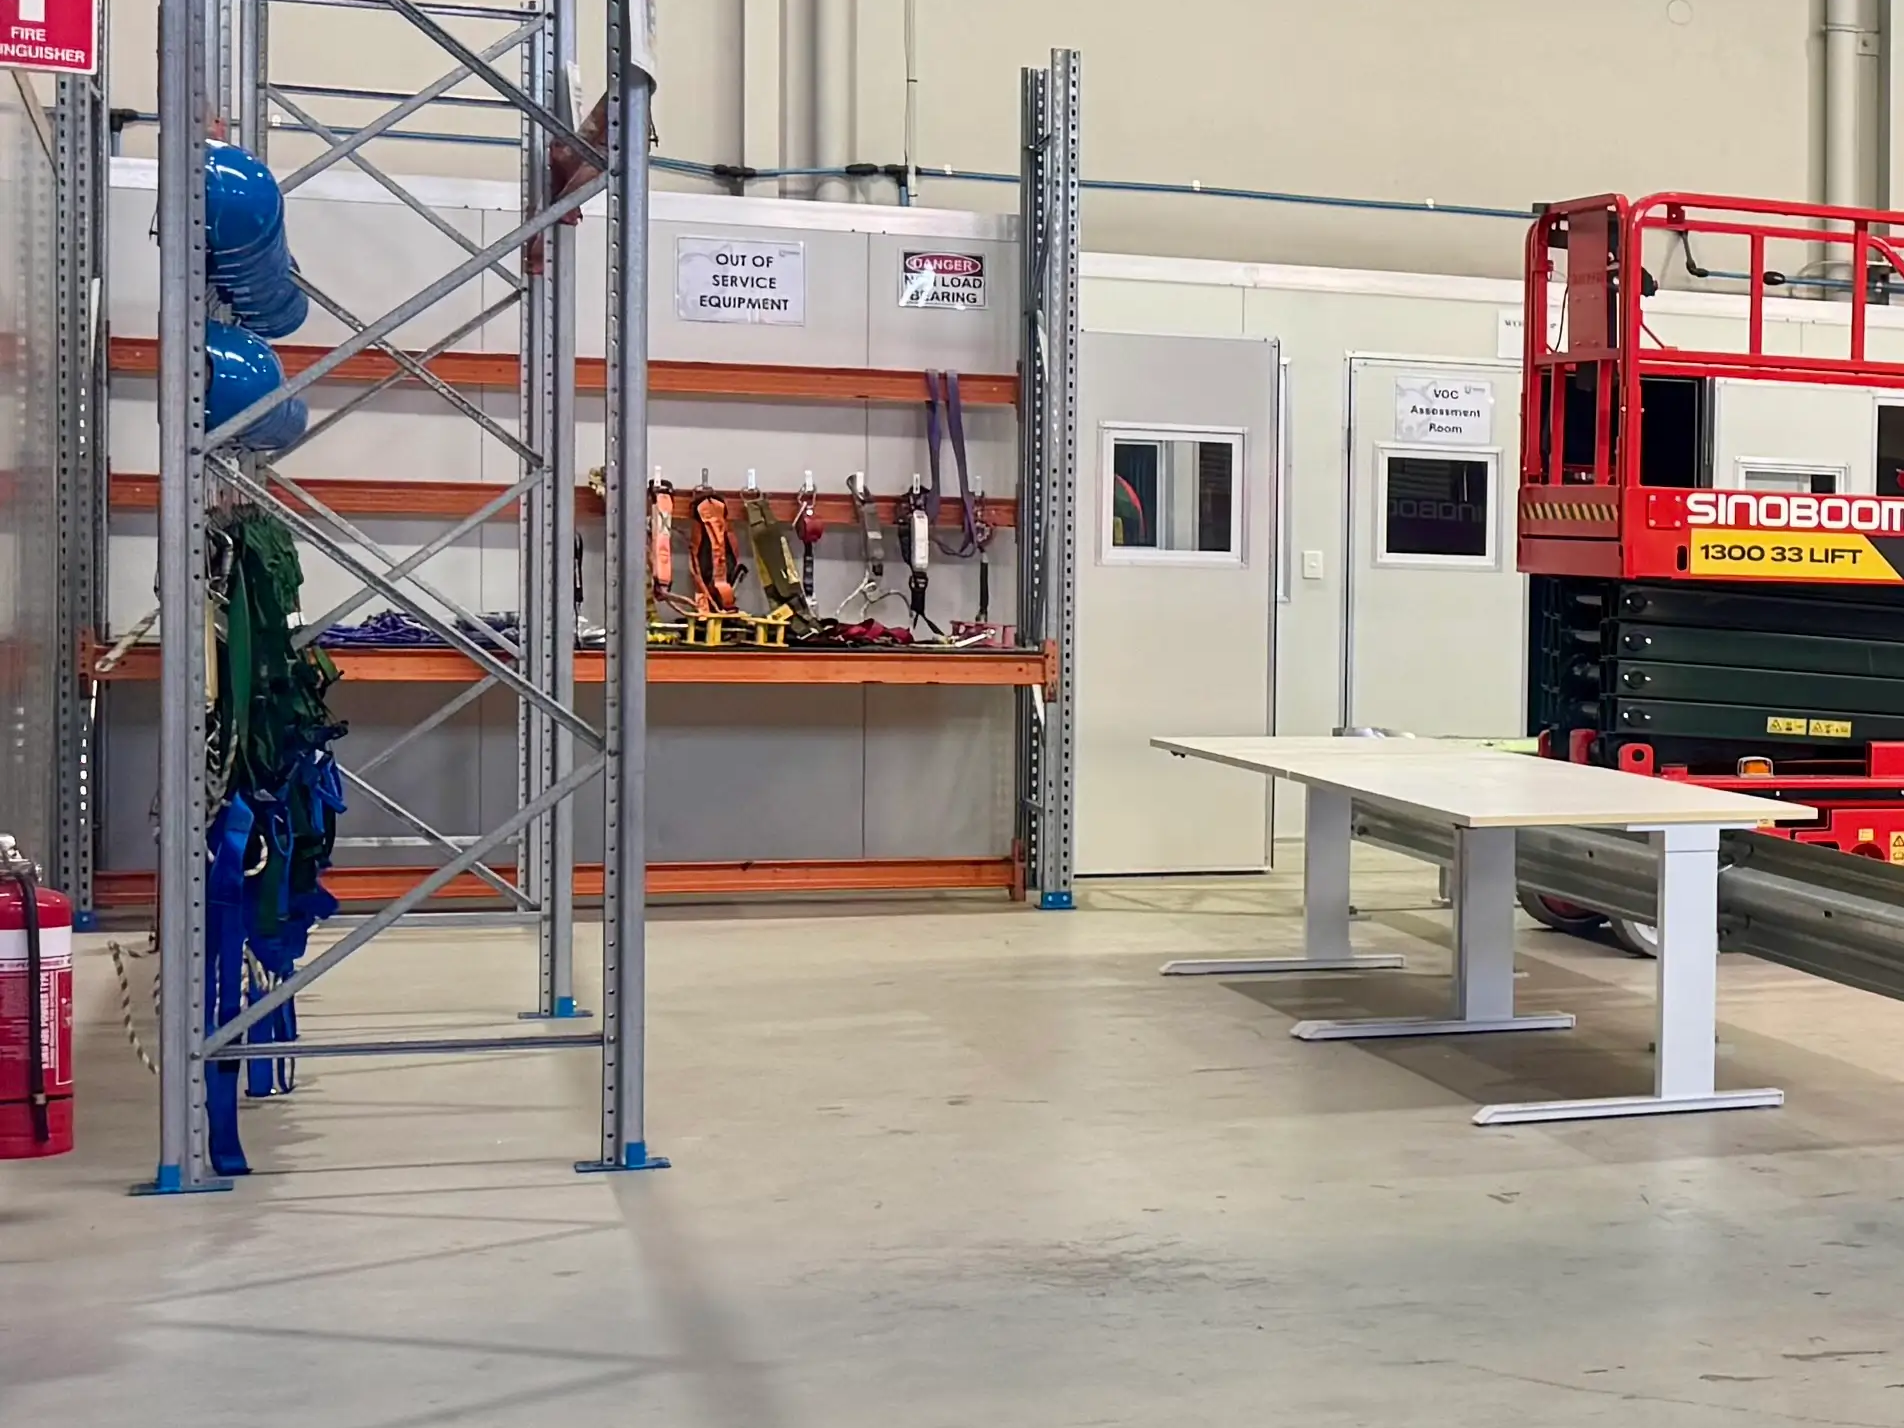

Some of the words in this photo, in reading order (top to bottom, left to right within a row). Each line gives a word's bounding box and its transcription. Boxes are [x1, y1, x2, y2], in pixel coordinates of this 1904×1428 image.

[11, 26, 46, 42] FIRE
[715, 253, 746, 267] OUT
[752, 255, 774, 268] OF
[912, 258, 973, 272] DANGER
[712, 274, 777, 290] SERVICE
[942, 276, 982, 289] LOAD
[700, 295, 789, 311] EQUIPMENT
[1433, 389, 1459, 400] VOC
[1429, 422, 1463, 434] Room
[1700, 544, 1765, 562] 1300
[1771, 546, 1804, 563] 33
[1809, 547, 1863, 565] LIFT
